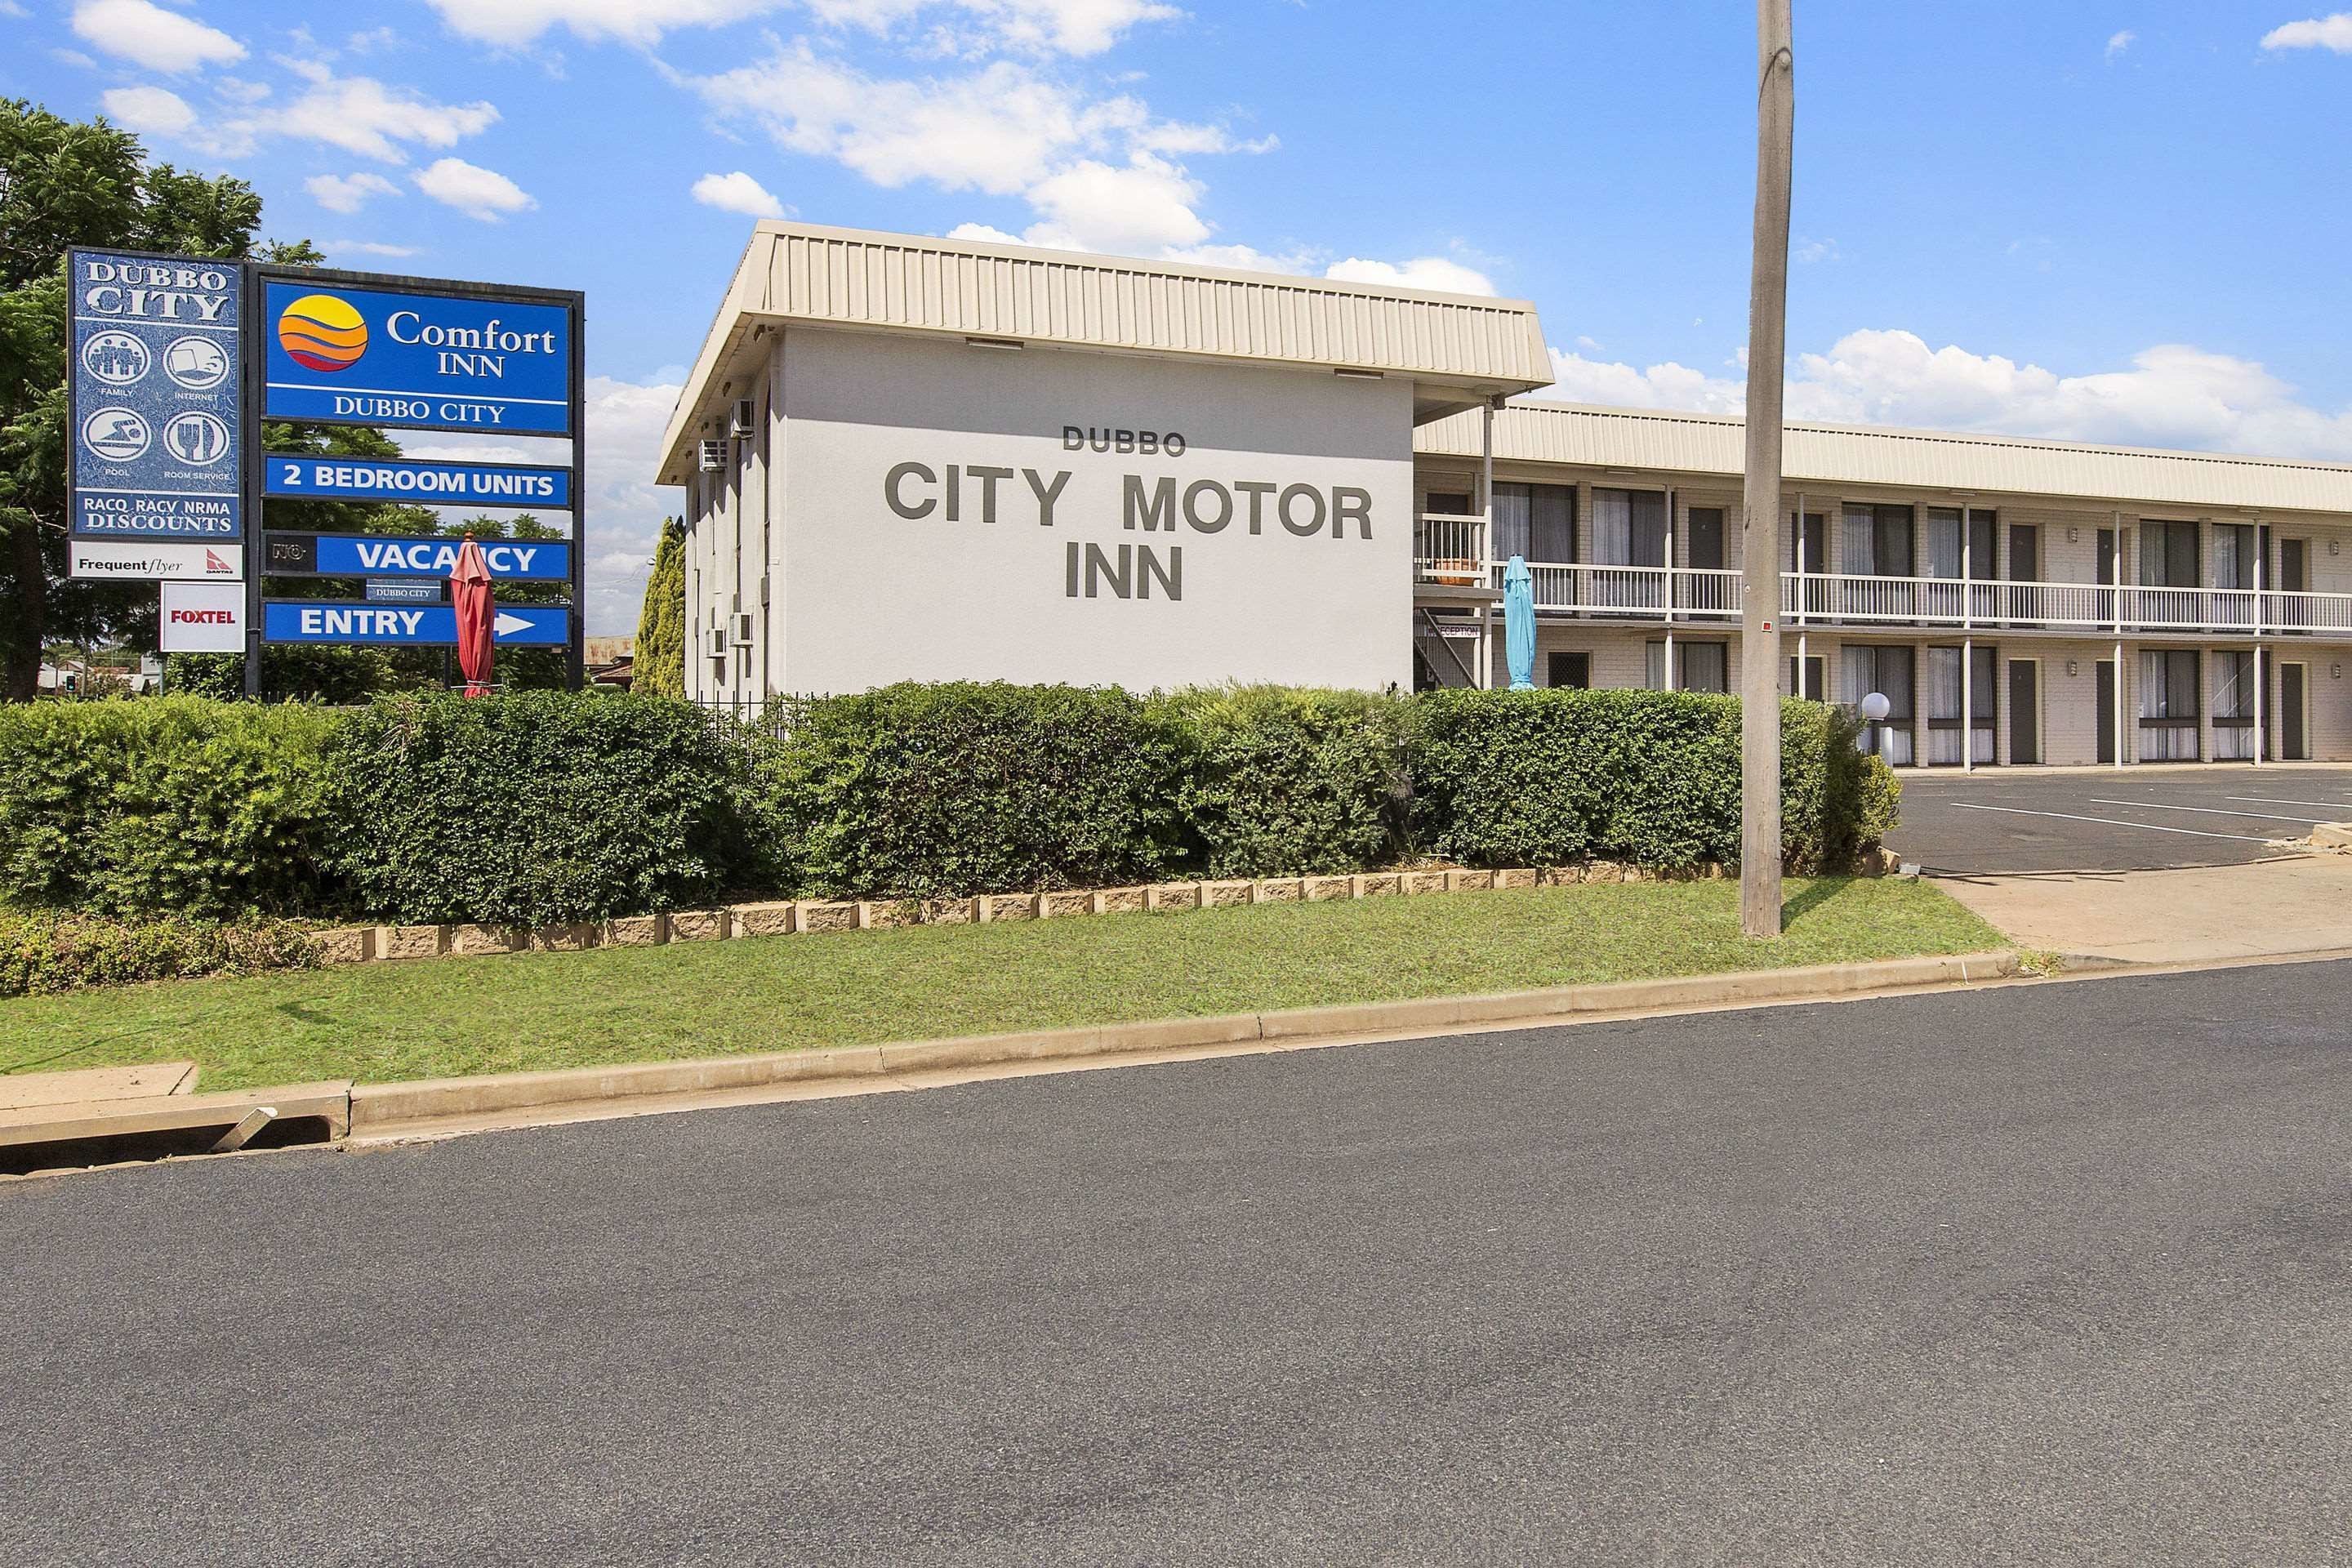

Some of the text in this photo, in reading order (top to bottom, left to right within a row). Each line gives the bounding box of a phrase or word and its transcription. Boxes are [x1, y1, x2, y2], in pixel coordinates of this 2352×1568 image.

[87, 262, 228, 290] DUBBO
[86, 287, 229, 321] CITY
[386, 310, 556, 354] Comfort
[438, 352, 506, 378] INN
[100, 388, 133, 397] FAMILY
[174, 392, 219, 401] INTERNET
[333, 395, 506, 424] DUBBO CITY
[1062, 425, 1186, 458] DUBBO
[105, 468, 130, 477] POOL
[164, 471, 229, 480] ROOM SERVICE
[283, 464, 554, 496] 2 BEDROOM UNITS
[84, 497, 230, 514] RACQ RACV NRMA
[884, 461, 1373, 540] CITY MOTOR
[86, 514, 232, 532] DISCOUNTS
[273, 543, 537, 572] NO VACACY
[1066, 541, 1183, 601] INN
[171, 610, 235, 624] FOXTEL
[301, 609, 425, 636] ENTRY
[1437, 626, 1478, 636] ECEPTION
